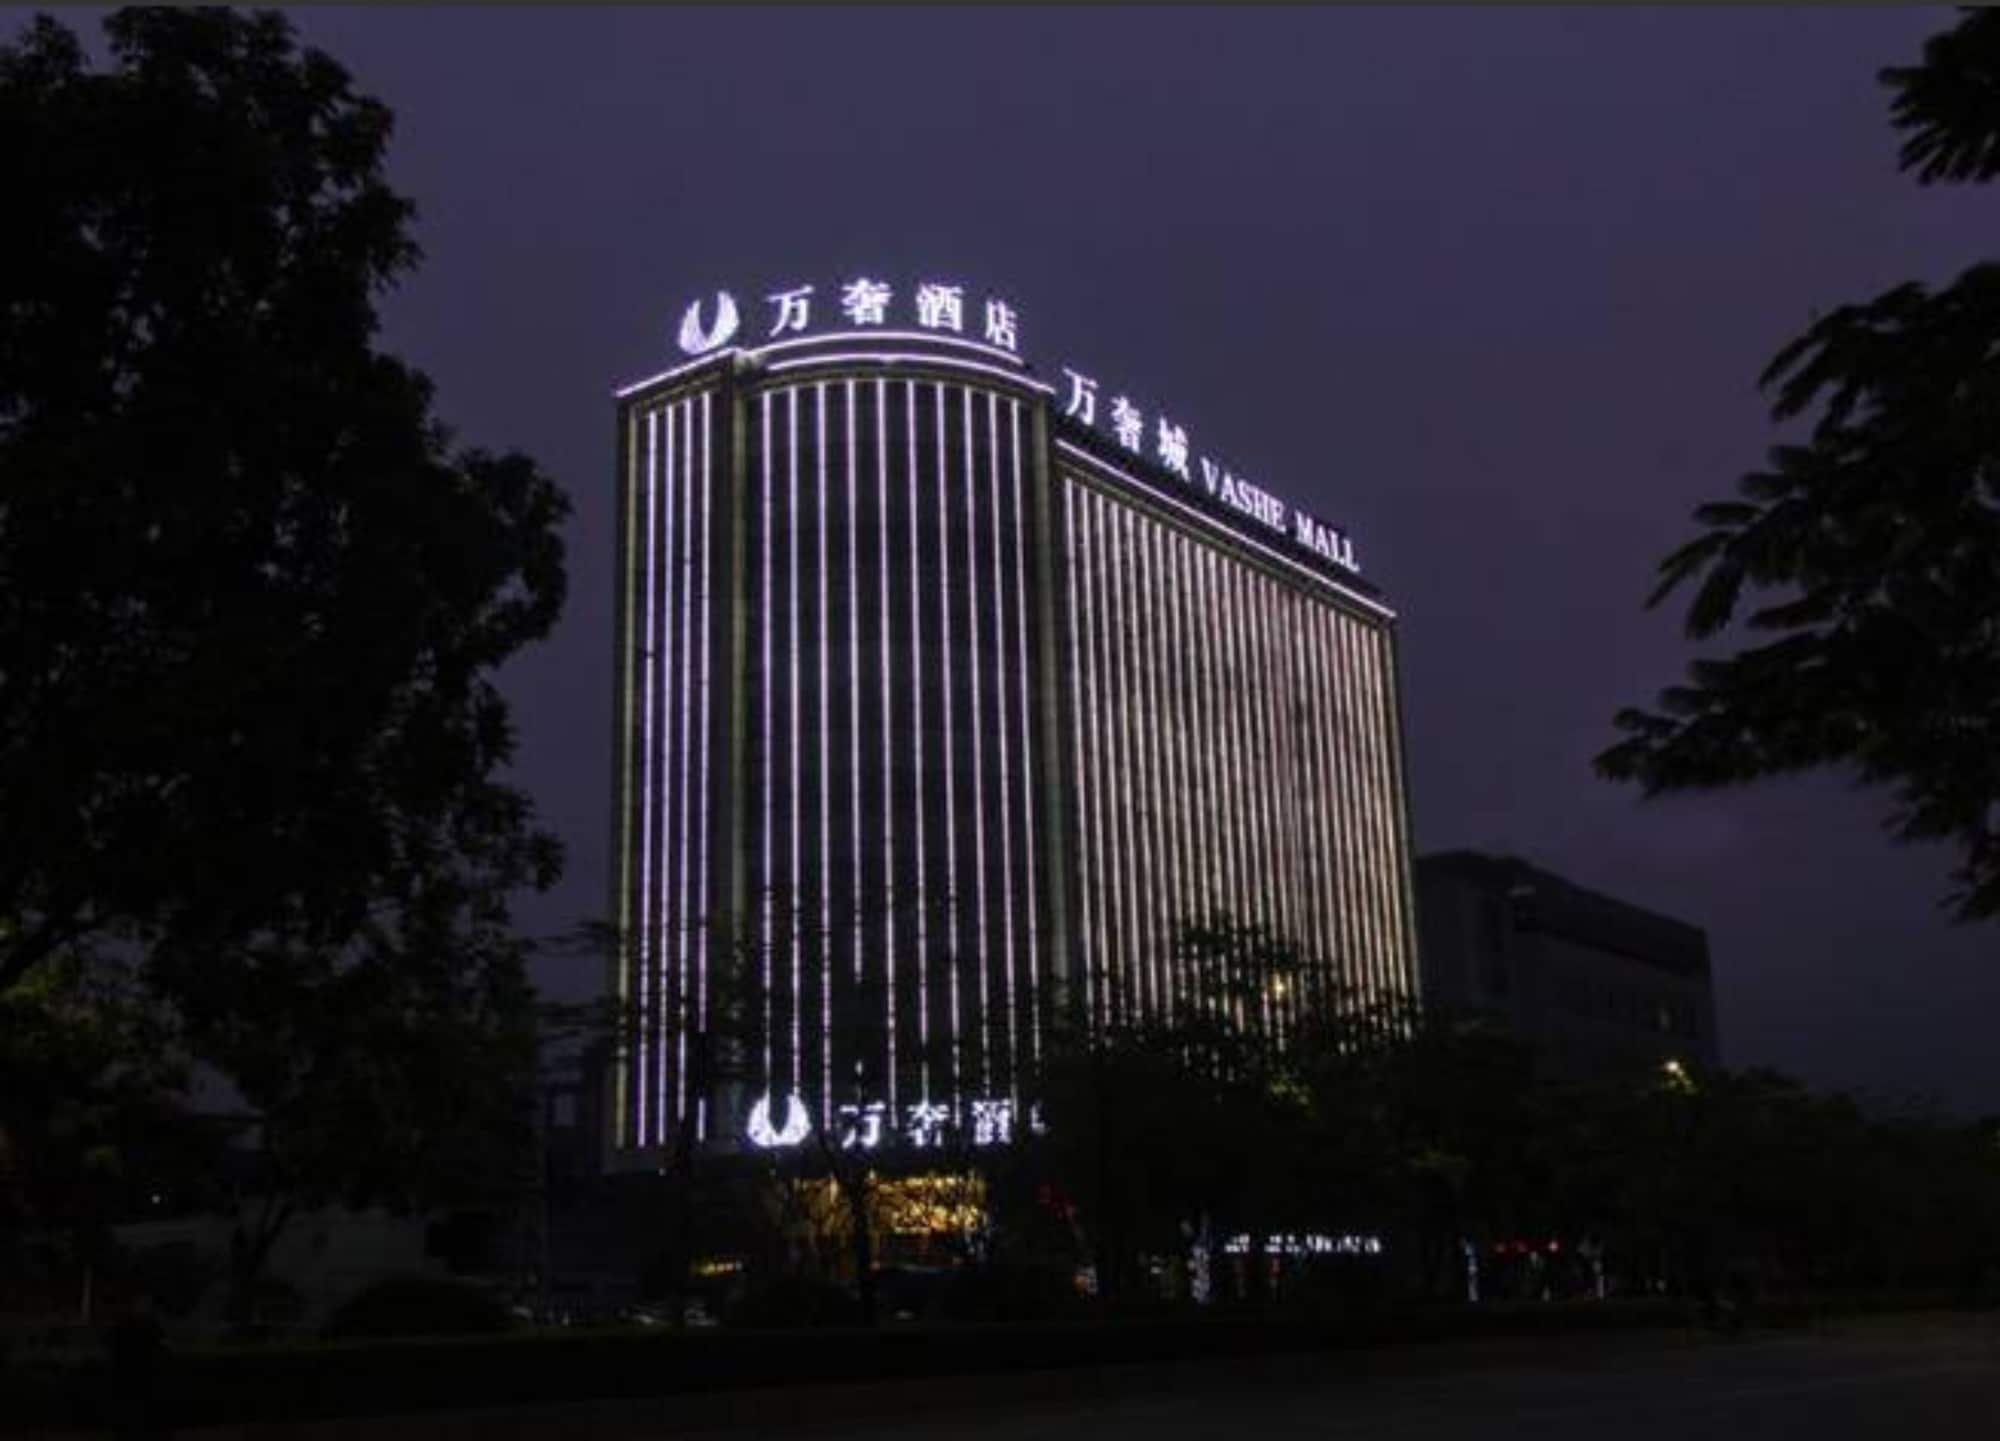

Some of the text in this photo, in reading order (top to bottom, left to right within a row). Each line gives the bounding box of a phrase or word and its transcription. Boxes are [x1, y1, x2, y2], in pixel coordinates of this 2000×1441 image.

[767, 278, 1019, 351] 万奢酒店
[1063, 367, 1361, 572] 万奢城 VASHE MALL
[840, 1098, 1046, 1149] 万奢酒
